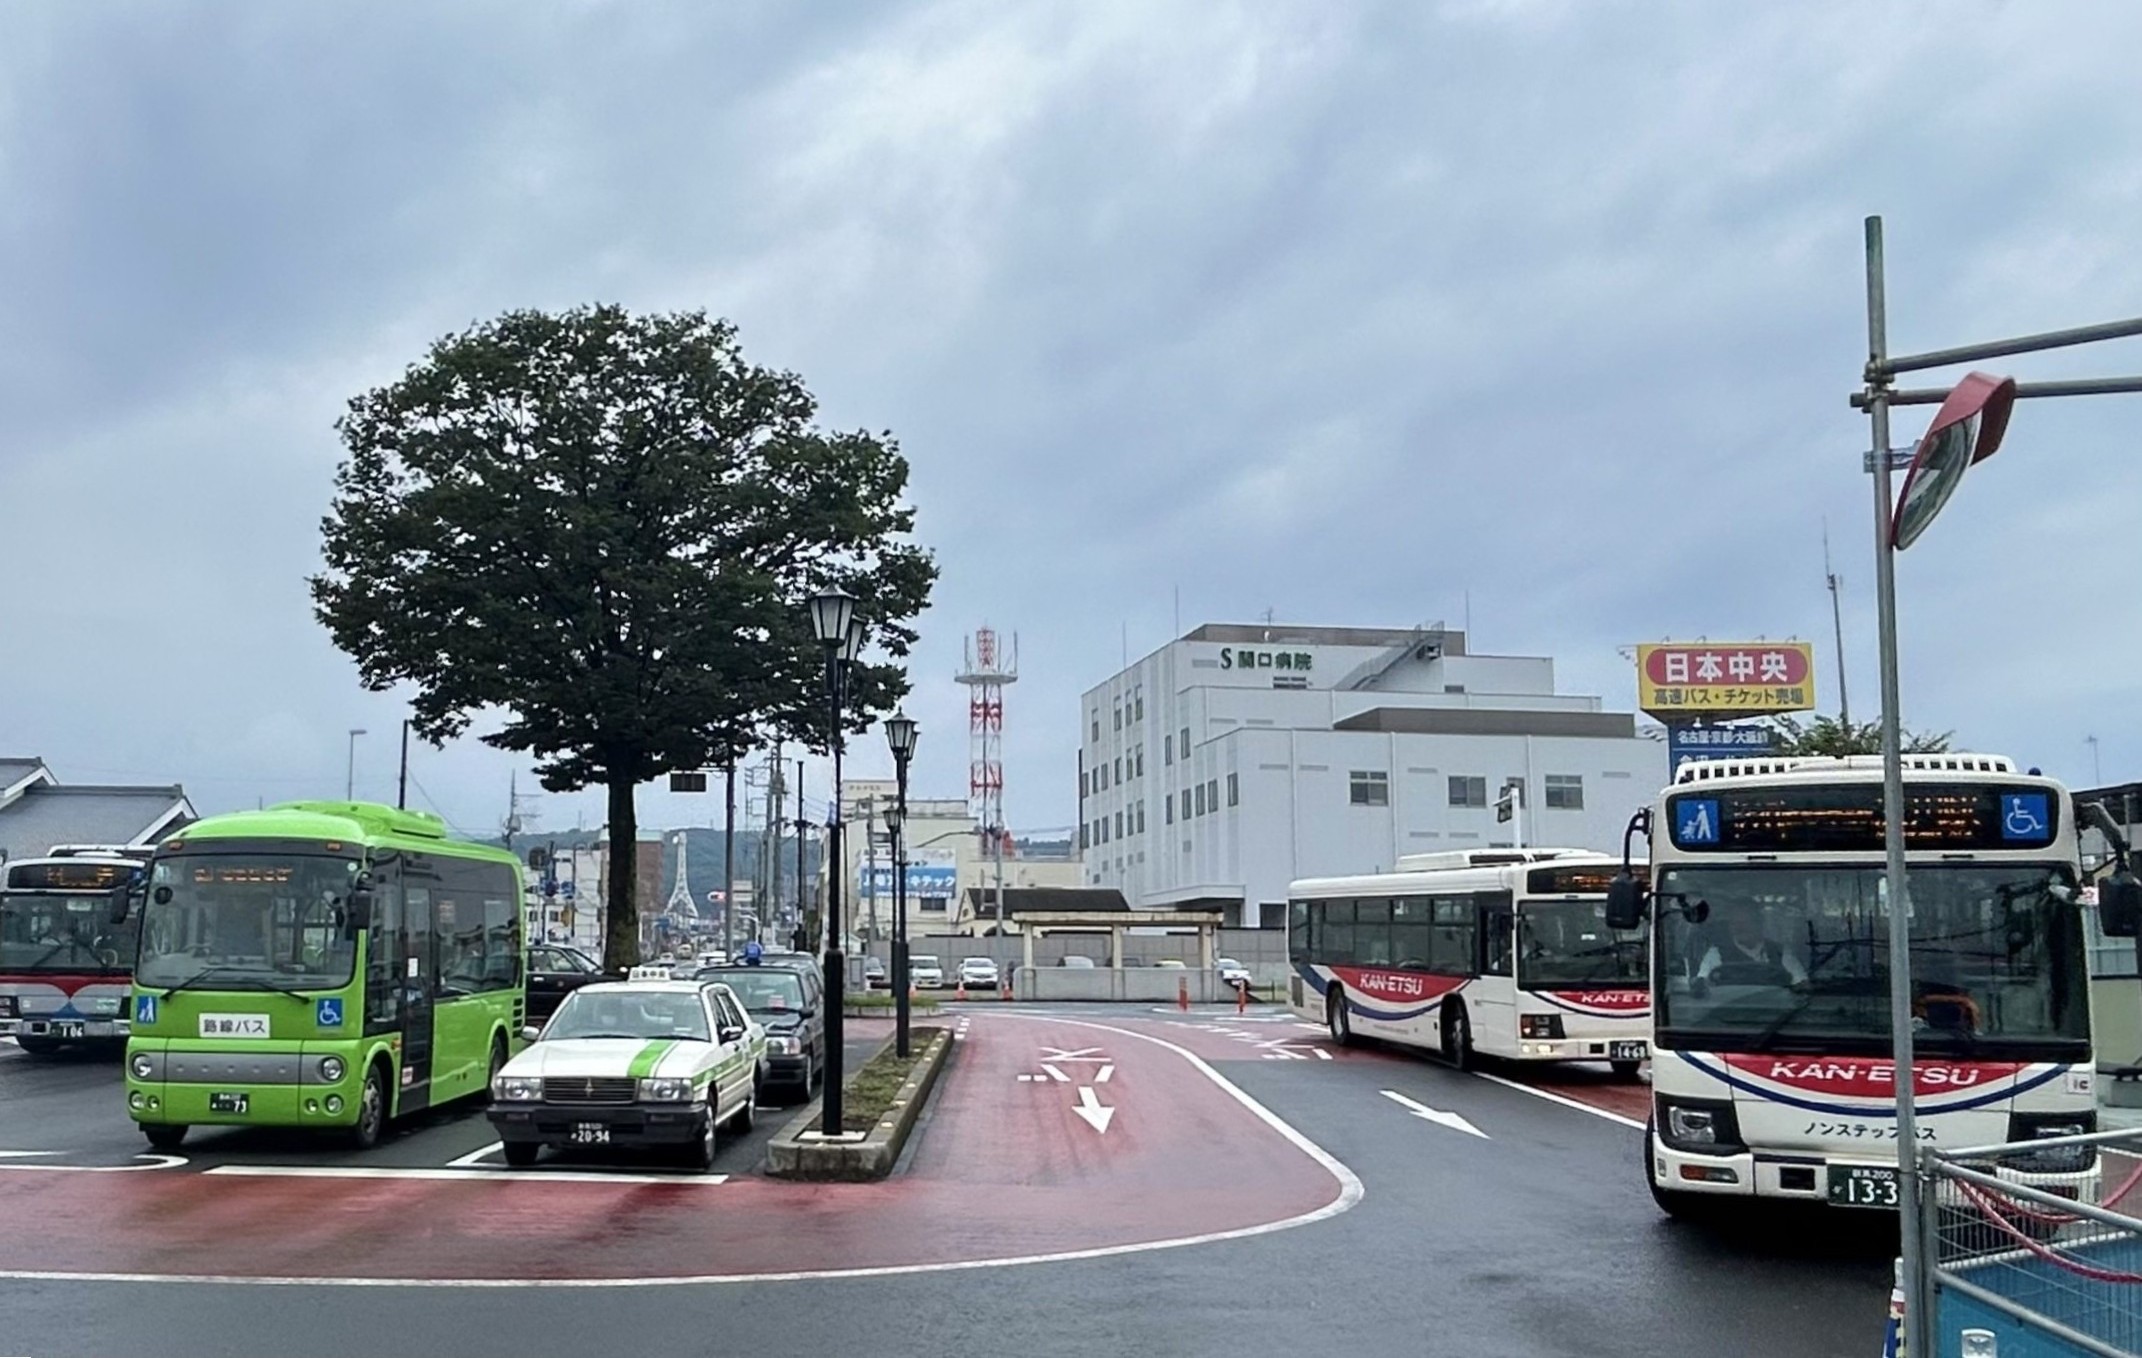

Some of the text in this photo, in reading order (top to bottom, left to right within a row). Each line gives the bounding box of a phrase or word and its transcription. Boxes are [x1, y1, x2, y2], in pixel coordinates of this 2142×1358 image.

[1665, 651, 1788, 683] 日本中央
[1654, 688, 1804, 705] 高速バス・チケット売場
[204, 1019, 265, 1033] 路線バス
